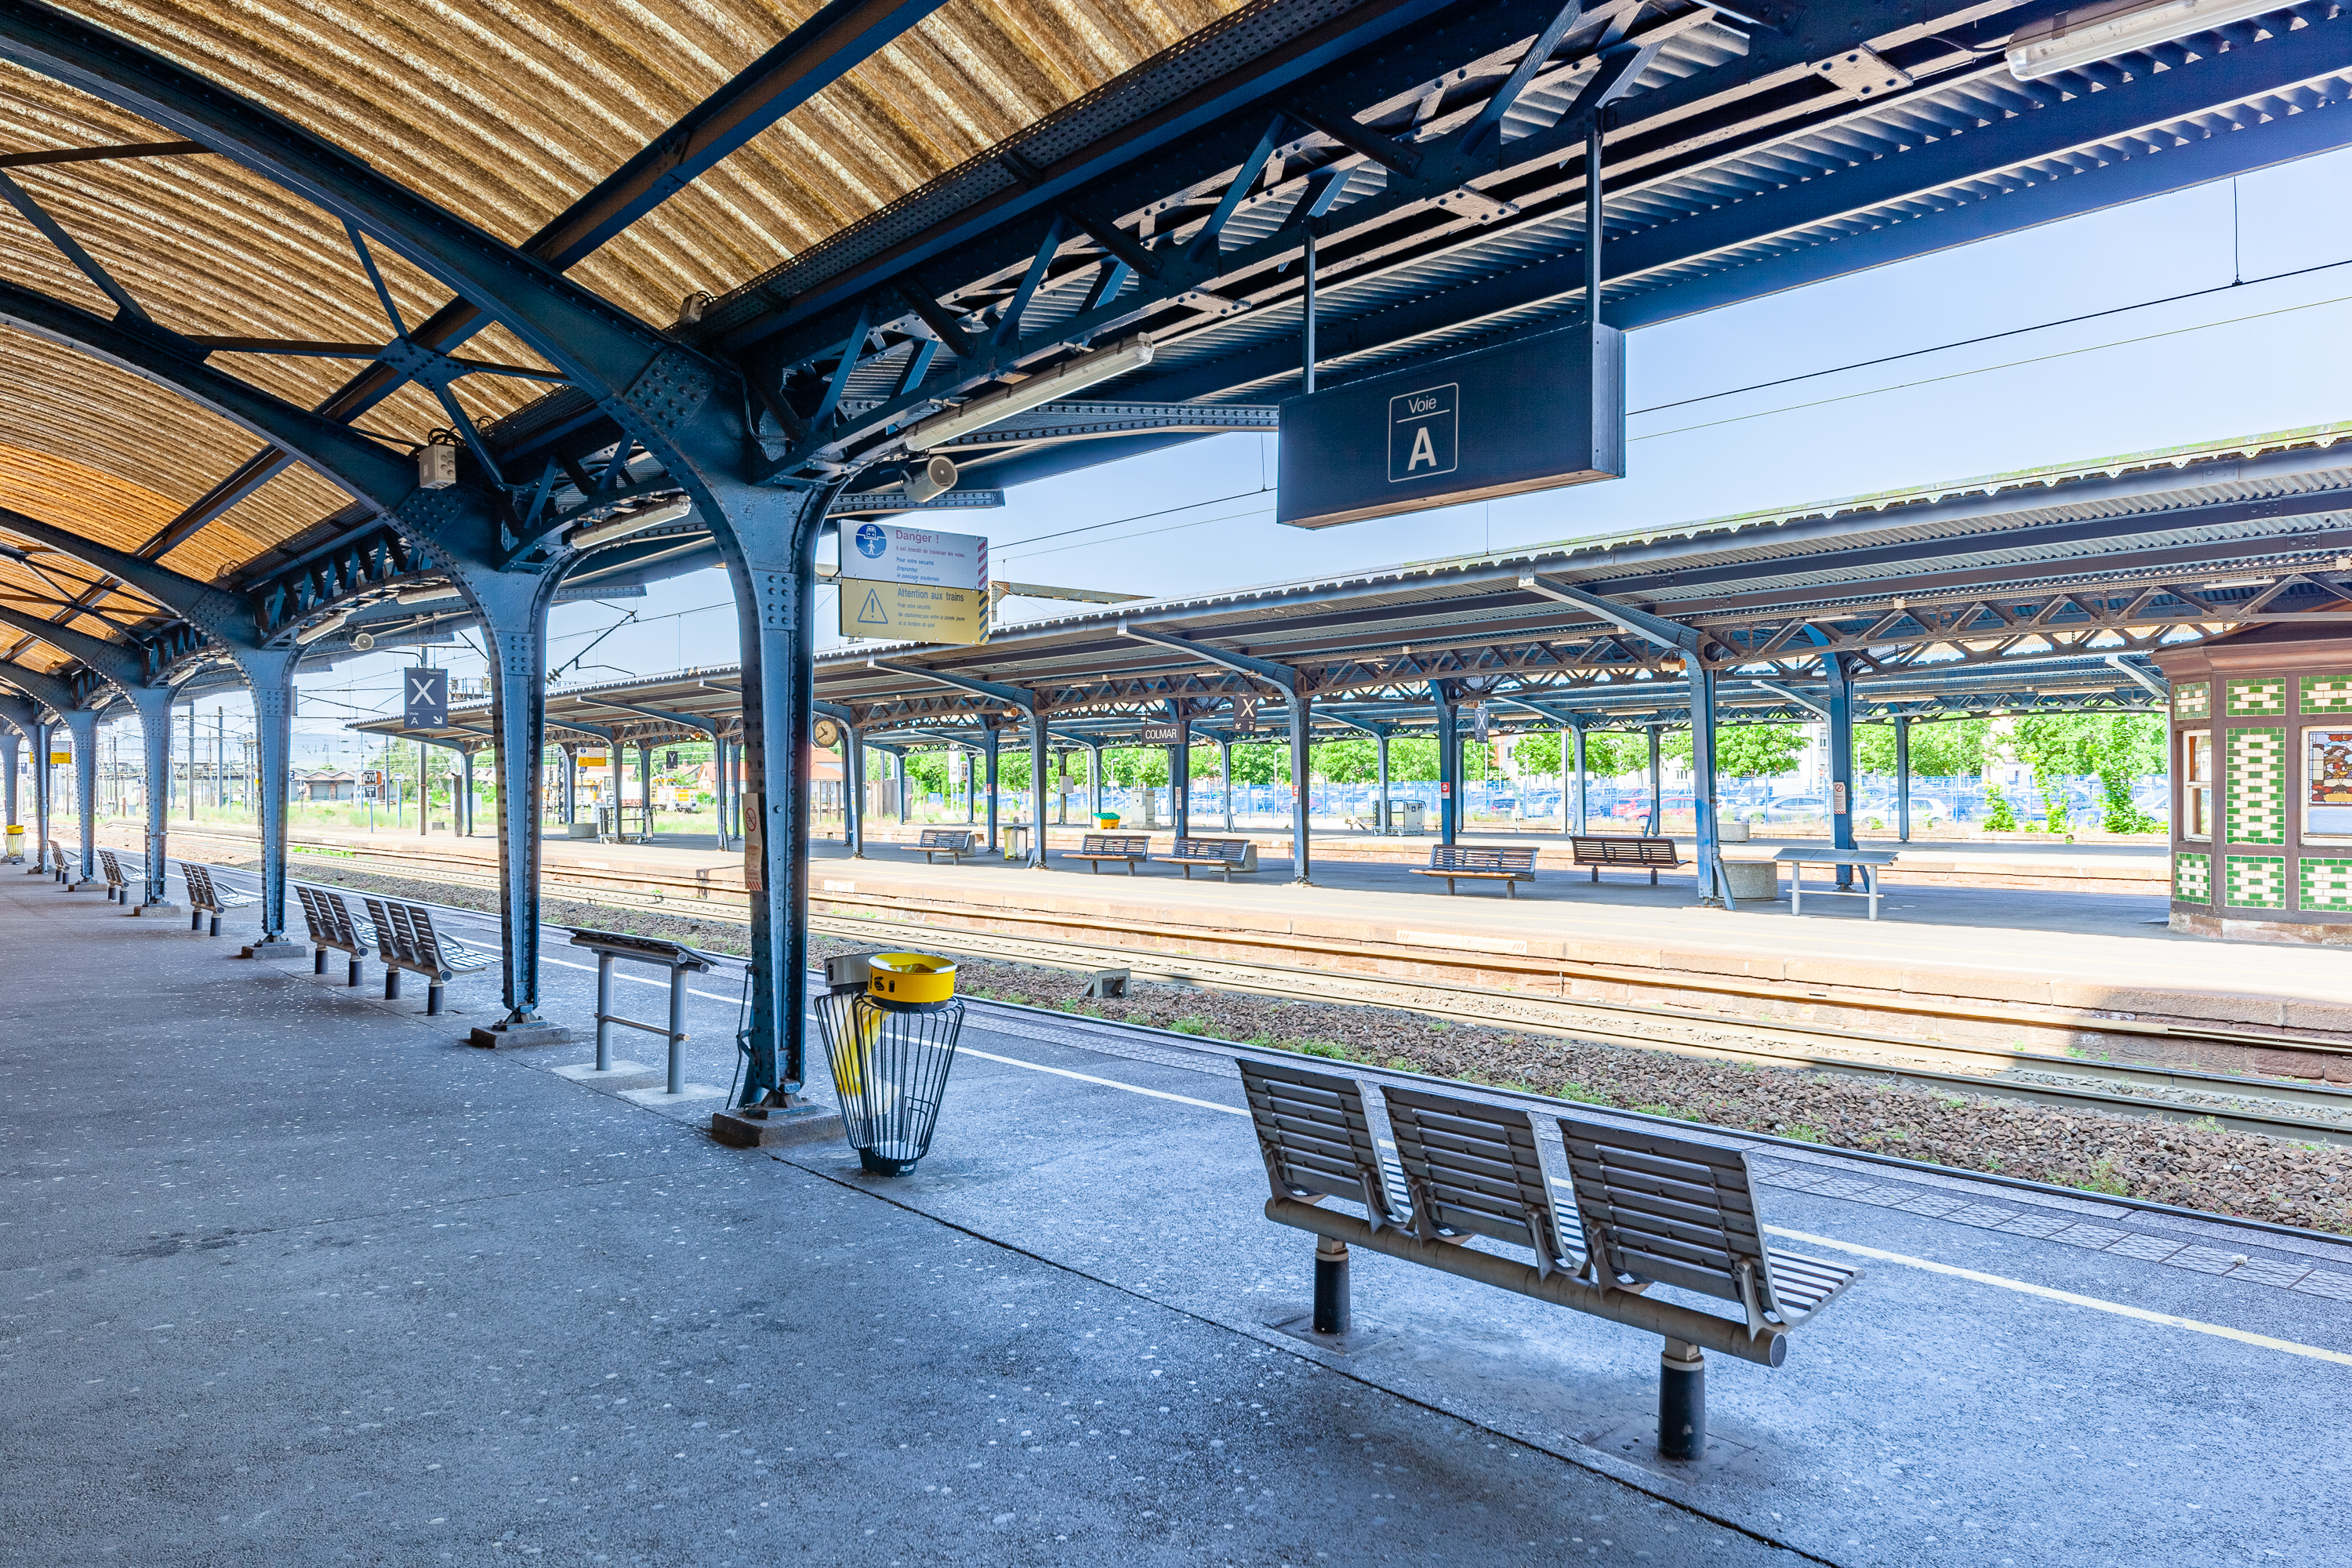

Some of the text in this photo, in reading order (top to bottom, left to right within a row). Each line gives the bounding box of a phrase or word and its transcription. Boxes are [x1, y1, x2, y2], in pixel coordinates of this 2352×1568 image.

[1409, 395, 1436, 413] Voie
[1408, 427, 1436, 470] A
[896, 530, 931, 543] Danger
[898, 588, 928, 599] Attention
[946, 592, 964, 601] trains
[410, 678, 436, 705] X
[1240, 699, 1256, 717] X
[1478, 713, 1486, 729] X
[1145, 729, 1177, 739] COLMAR
[669, 753, 675, 762] Y
